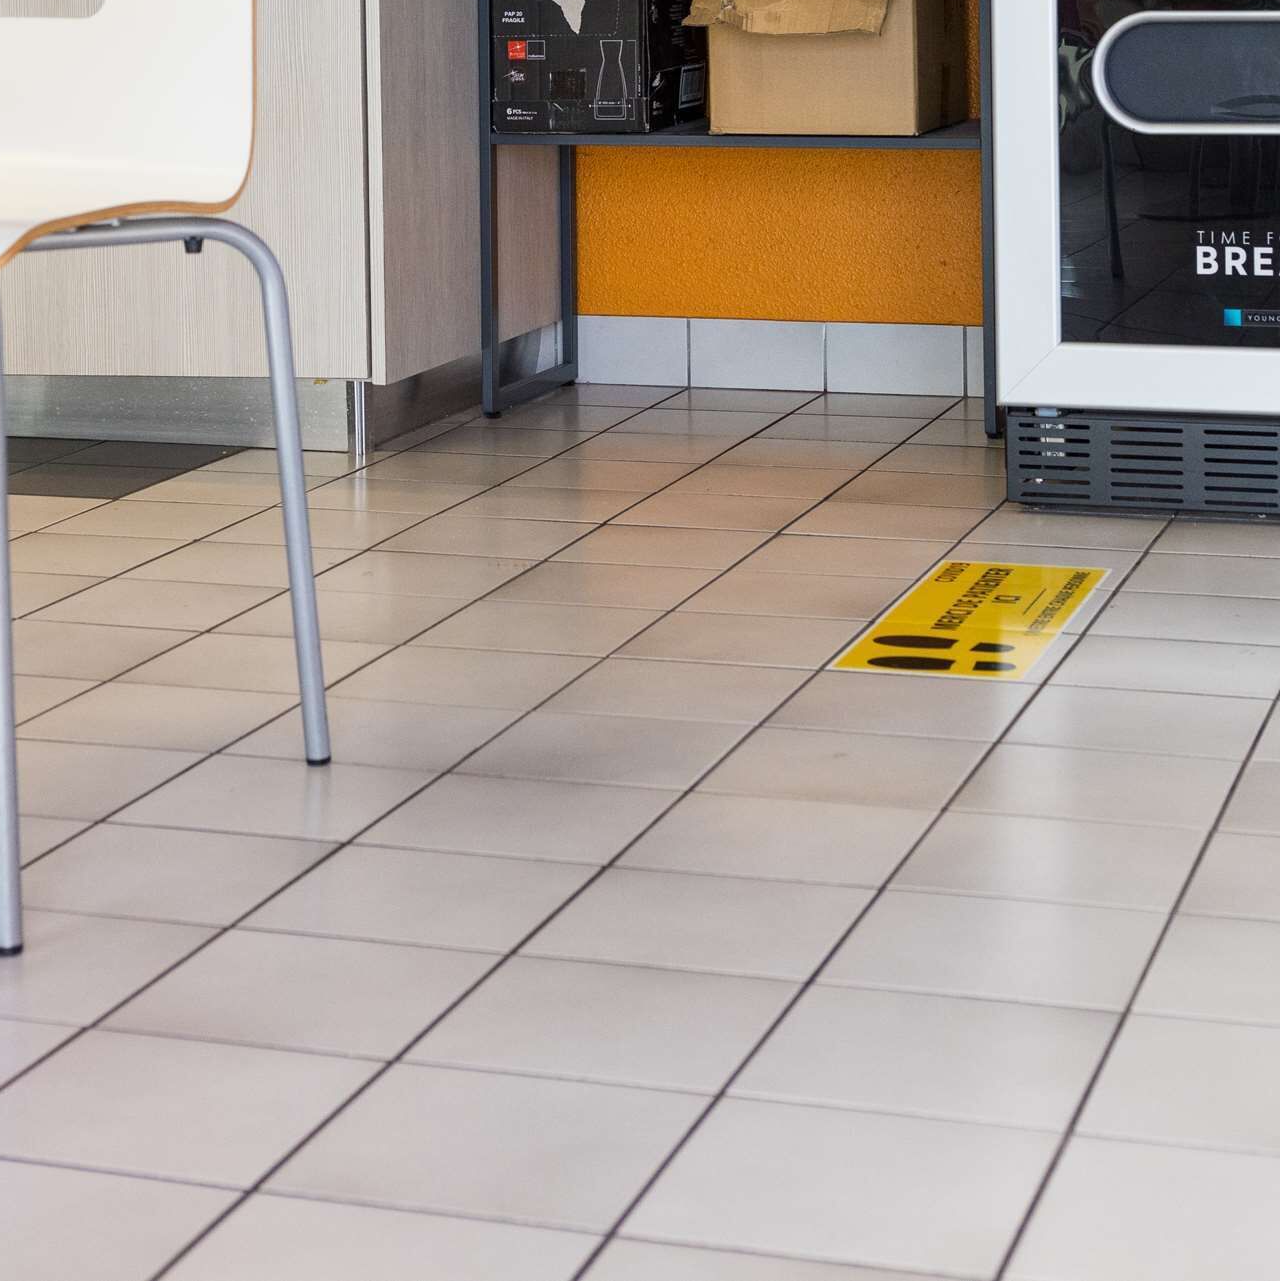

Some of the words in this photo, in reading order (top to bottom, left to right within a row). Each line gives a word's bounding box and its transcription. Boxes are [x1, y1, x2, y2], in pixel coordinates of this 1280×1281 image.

[1196, 230, 1251, 245] TIME
[960, 567, 1016, 599] PATIENTER
[951, 598, 984, 608] DE
[991, 595, 1021, 604] ICI
[931, 607, 975, 631] MERCI
